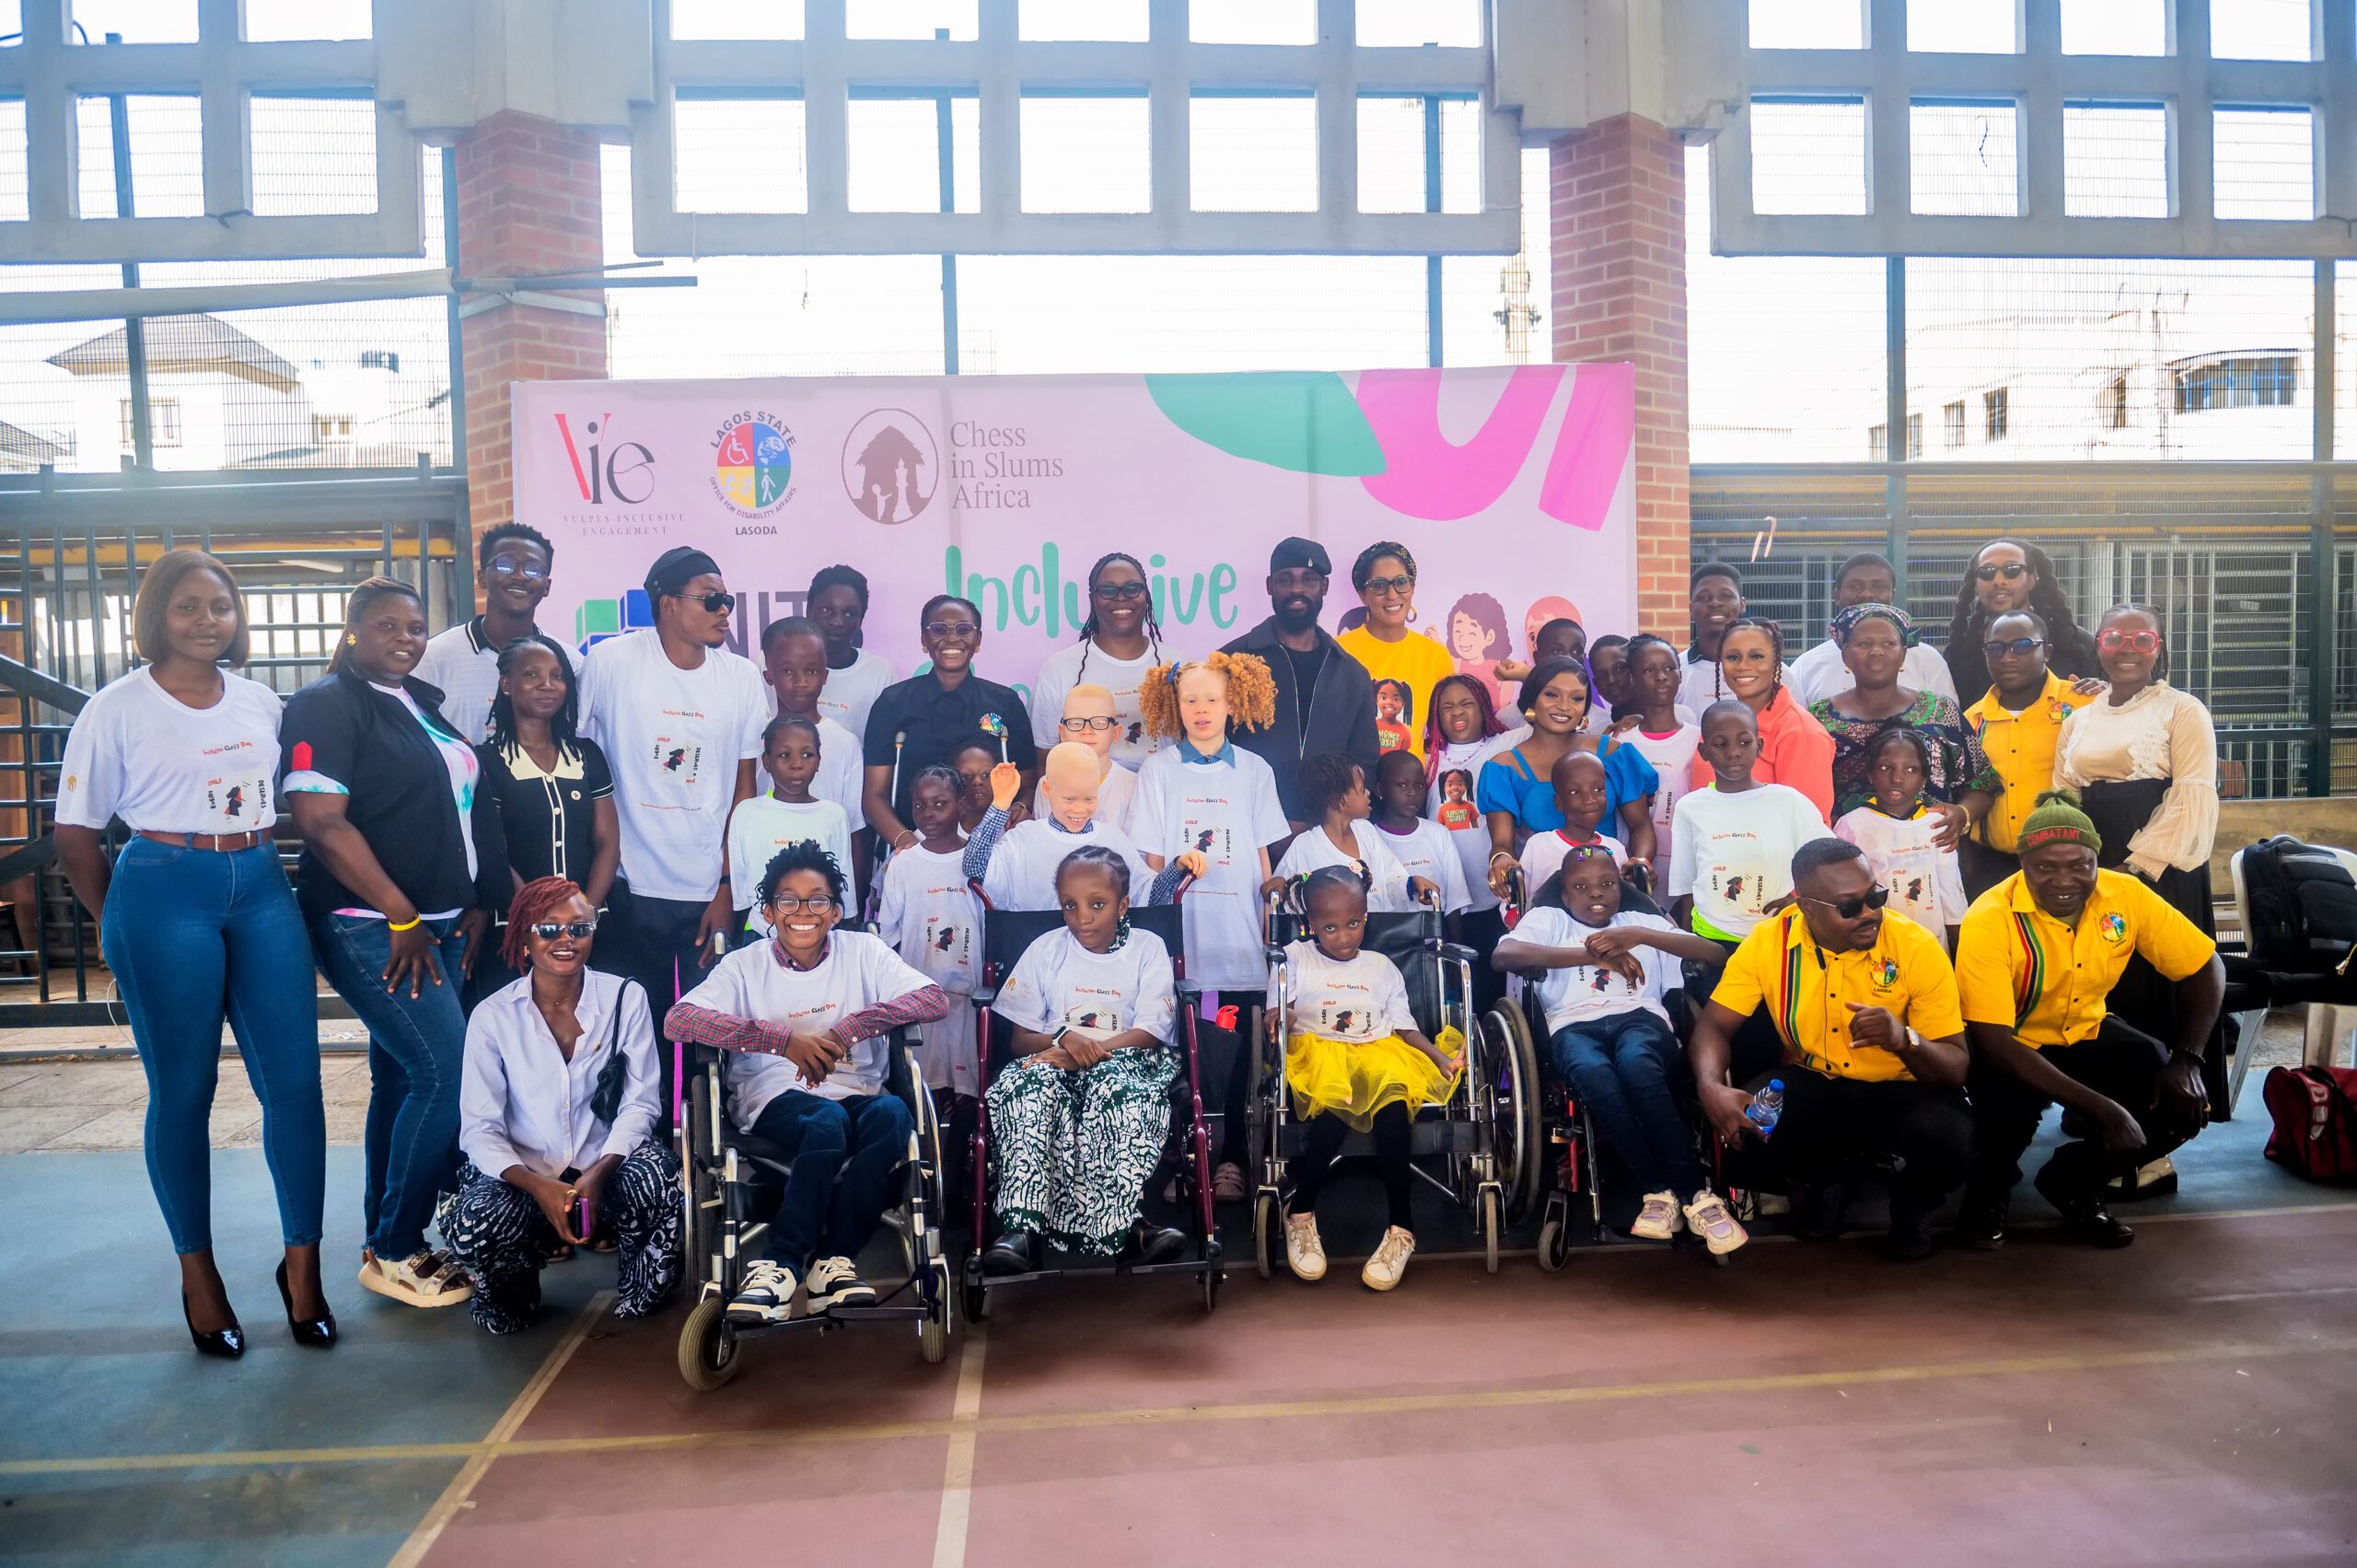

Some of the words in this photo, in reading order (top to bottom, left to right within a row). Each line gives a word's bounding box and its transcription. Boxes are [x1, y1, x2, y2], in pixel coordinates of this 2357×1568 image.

[710, 411, 751, 448] LAGOS
[757, 411, 796, 447] STATE
[950, 420, 1026, 447] Chess
[951, 453, 976, 478] in
[984, 451, 1063, 478] Slums
[710, 477, 725, 501] OFFICE
[724, 500, 736, 514] FOR
[737, 508, 774, 519] DISABILITY
[775, 487, 796, 513] AFFAIRS
[952, 482, 1031, 508] Africa
[563, 515, 610, 523] VULPES
[617, 513, 686, 522] INCLUSIVE
[583, 526, 668, 536] ENGAGEMENT
[736, 527, 777, 536] LASODA
[945, 541, 1238, 639] Incluive
[2026, 828, 2084, 848] COMBATANT
